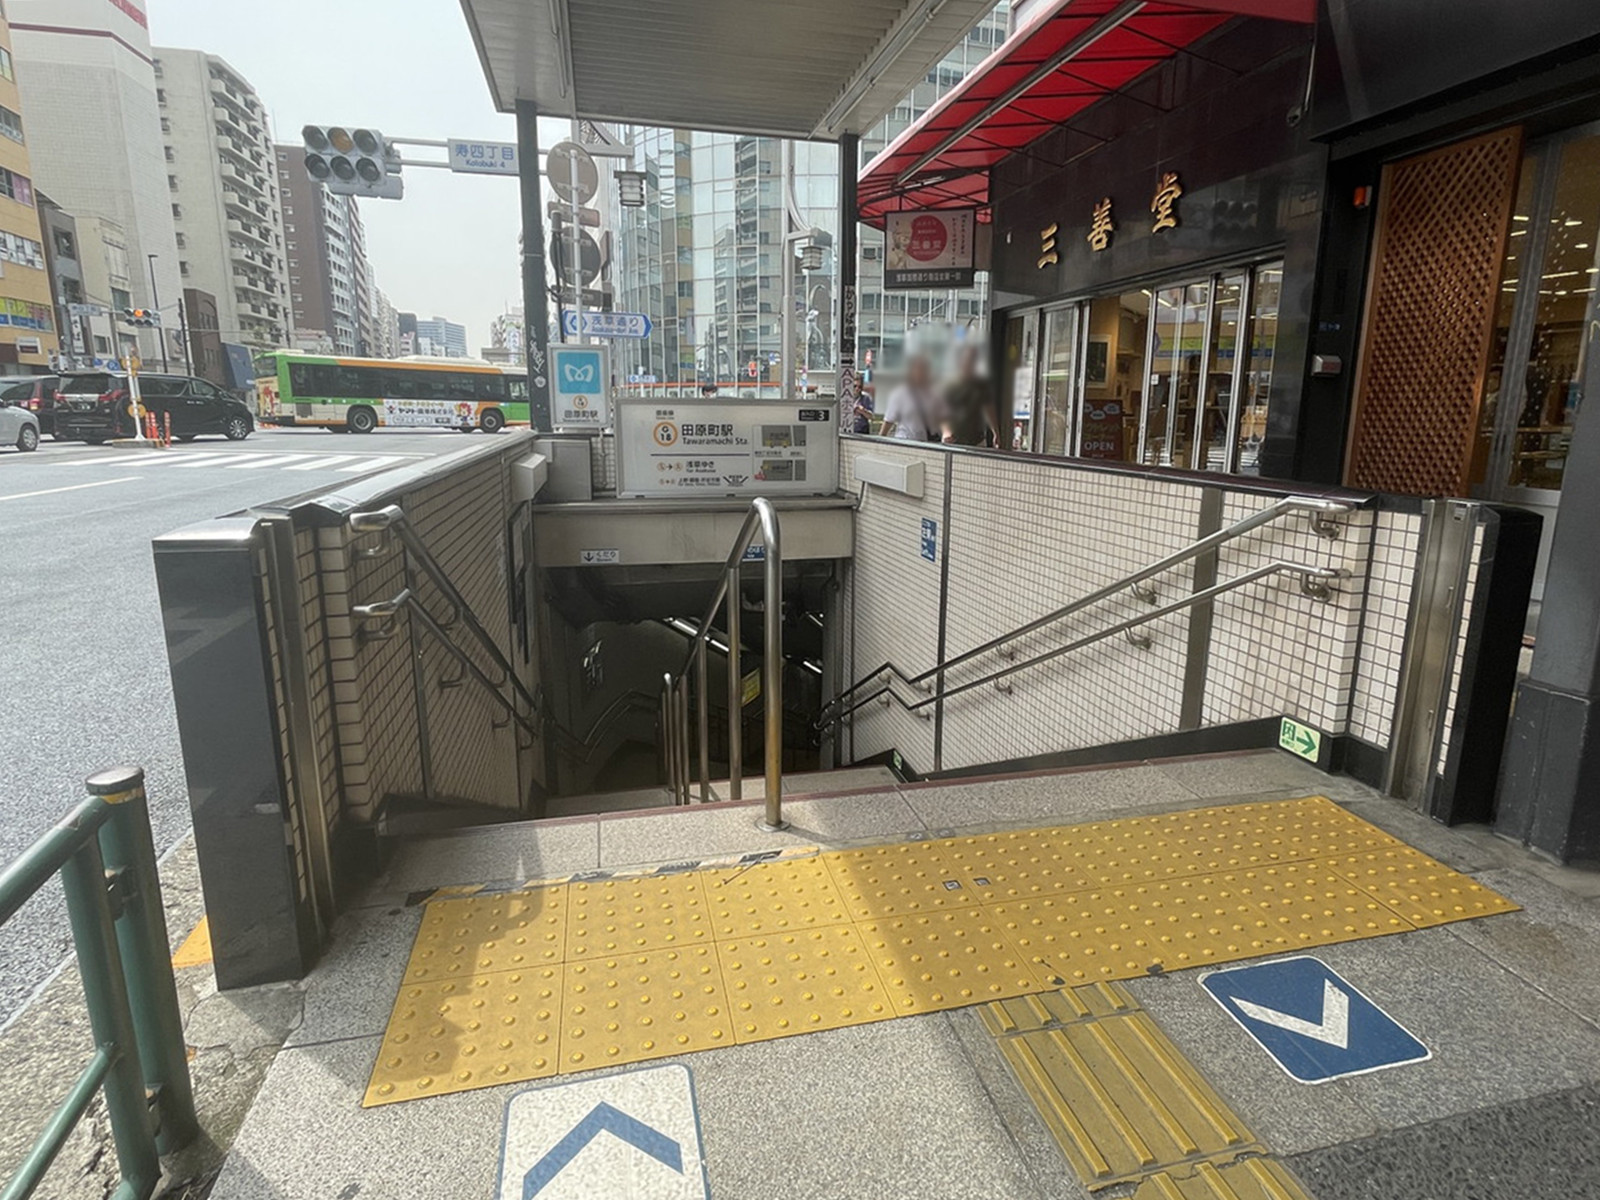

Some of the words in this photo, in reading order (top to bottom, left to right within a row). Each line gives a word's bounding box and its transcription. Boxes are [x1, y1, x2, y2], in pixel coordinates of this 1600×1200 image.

[455, 143, 514, 160] 寿四丁目
[465, 159, 497, 168] Kotobuki
[1037, 172, 1182, 268] 三善堂
[592, 315, 639, 327] 浅草通り
[818, 411, 825, 420] 3
[681, 424, 734, 437] 田原町駅
[660, 433, 672, 441] 18
[682, 437, 733, 445] Tawaramachi
[1084, 441, 1115, 450] OPEN
[597, 550, 617, 558] くだり
